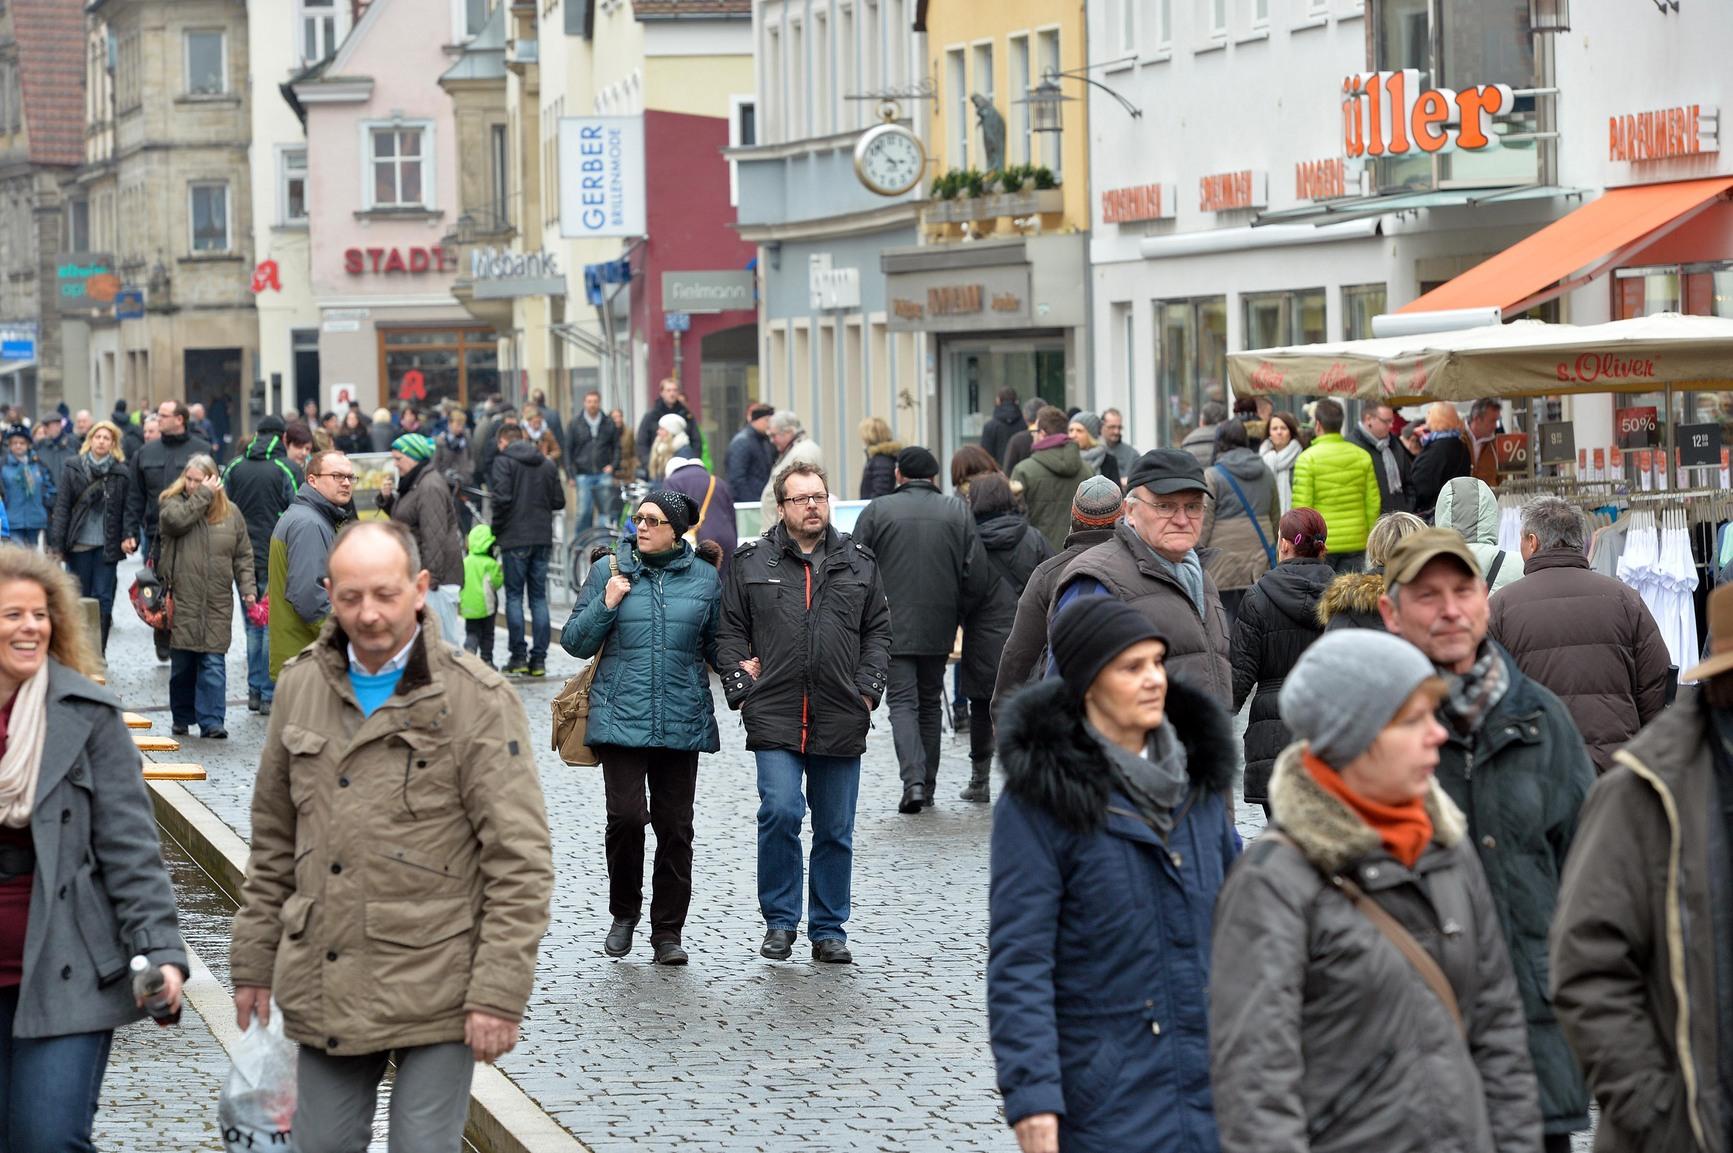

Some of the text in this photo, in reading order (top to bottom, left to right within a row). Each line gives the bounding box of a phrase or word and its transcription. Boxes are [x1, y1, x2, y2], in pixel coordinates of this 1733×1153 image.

[581, 126, 605, 230] GERBER
[609, 128, 624, 226] BRILLENMODE
[1622, 414, 1656, 433] 50%
